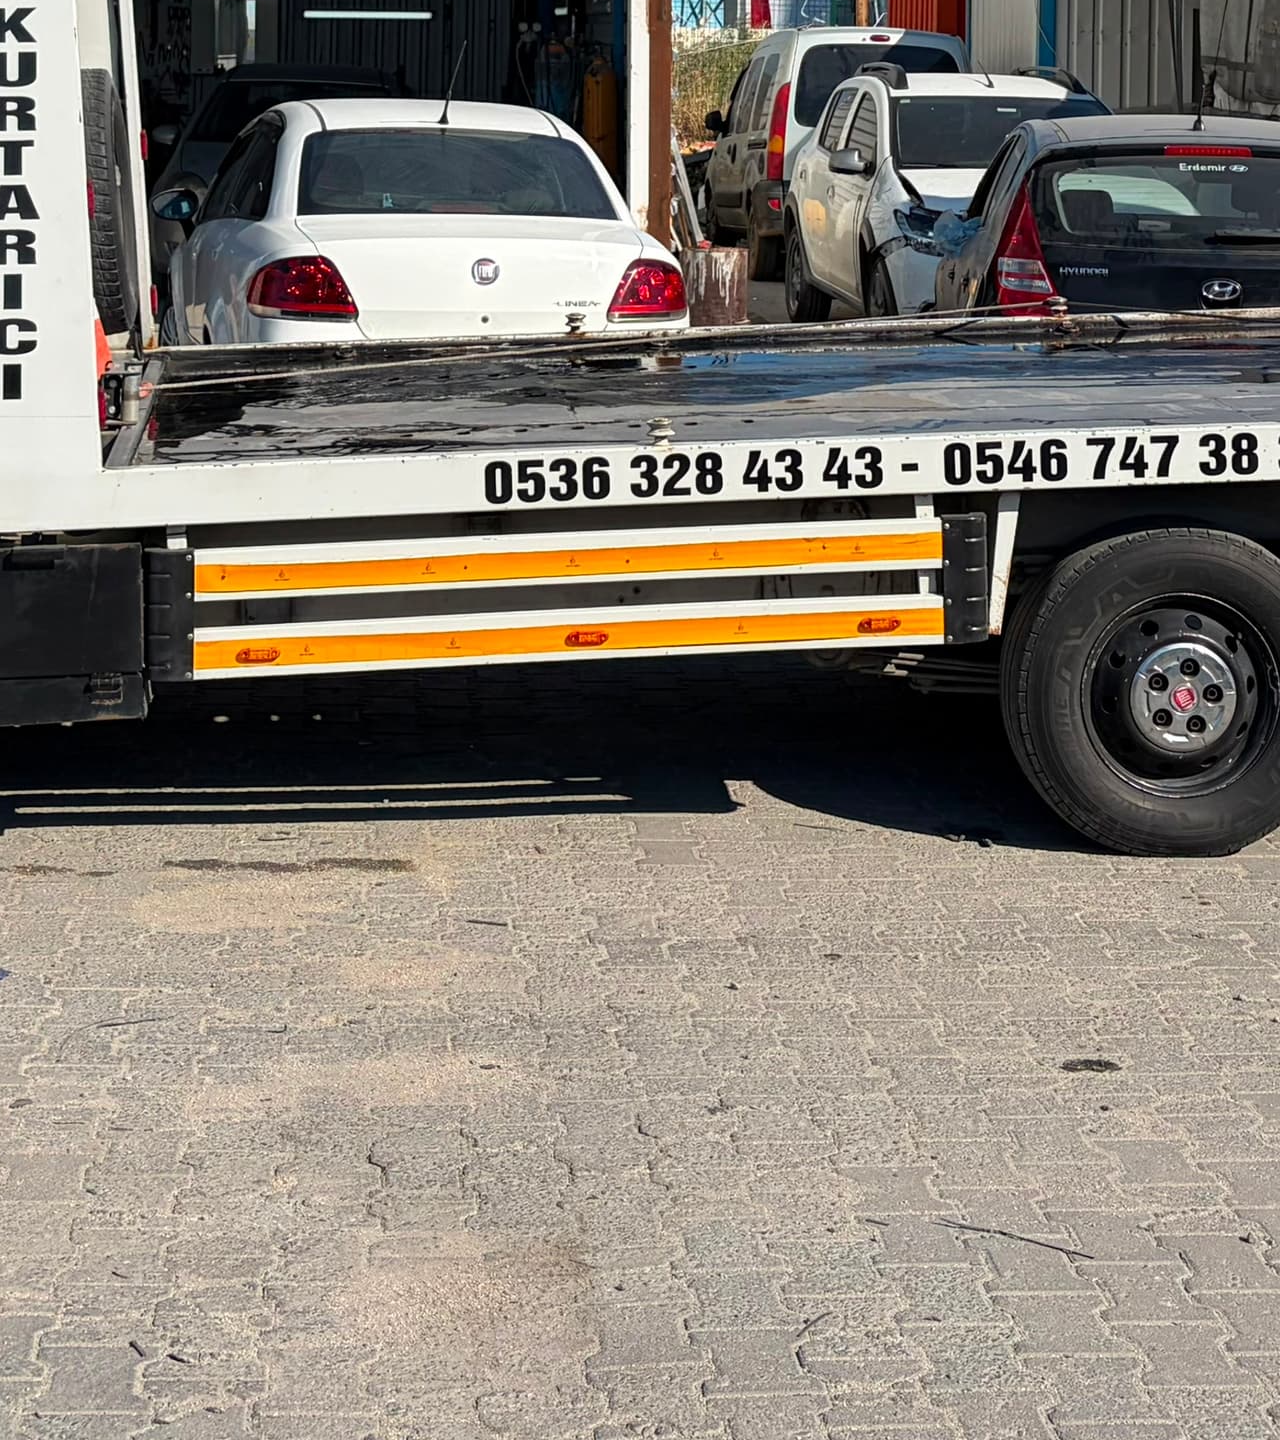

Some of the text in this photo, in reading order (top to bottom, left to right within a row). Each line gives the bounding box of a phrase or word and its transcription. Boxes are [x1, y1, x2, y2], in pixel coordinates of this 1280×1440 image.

[1179, 163, 1226, 172] Erdemir
[1059, 266, 1109, 276] HYUNDAI
[483, 457, 611, 504] 0536
[630, 452, 723, 498] 328
[743, 448, 803, 492] 43
[822, 446, 884, 490] 43
[901, 462, 919, 471] -
[943, 438, 1068, 485] 0546
[1086, 435, 1179, 480] 747
[1198, 432, 1259, 476] 38
